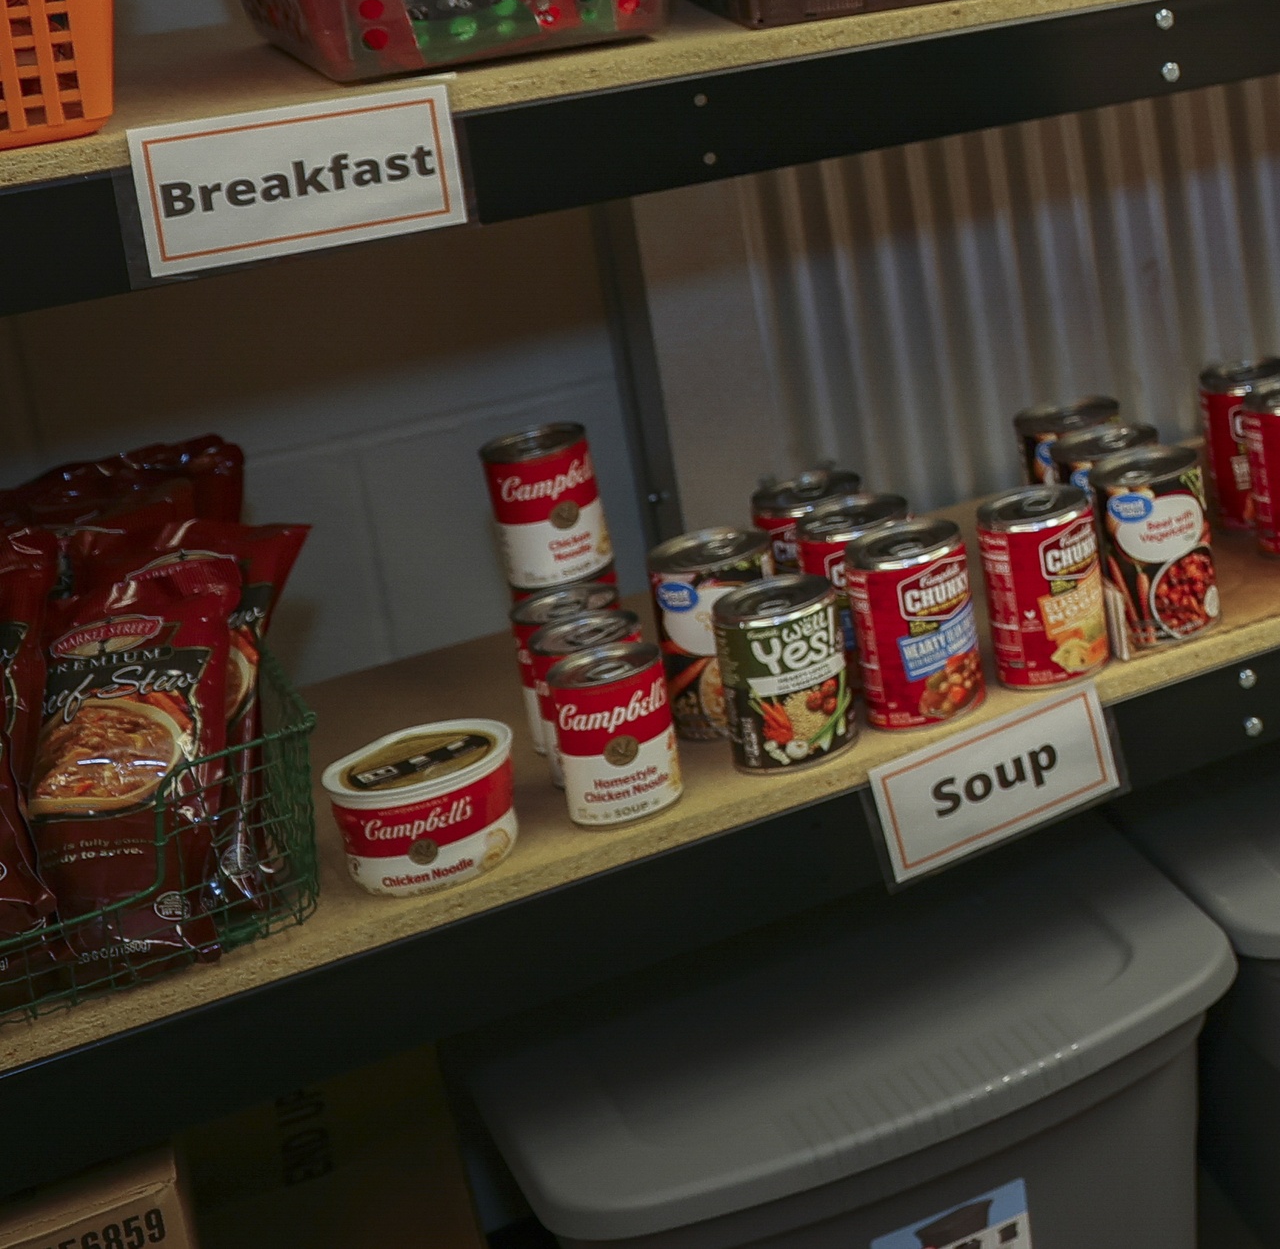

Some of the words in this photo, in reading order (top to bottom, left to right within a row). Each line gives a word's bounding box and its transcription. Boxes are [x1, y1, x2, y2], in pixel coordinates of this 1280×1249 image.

[160, 144, 436, 220] Breakfast
[57, 626, 108, 651] MARKET
[109, 622, 150, 636] STREET
[44, 674, 95, 724] eef
[97, 665, 197, 700] Stew
[555, 676, 666, 734] Campbell's
[584, 787, 631, 803] Chicken
[633, 773, 669, 794] Noodle
[593, 764, 658, 789] Homestyle
[932, 744, 1057, 819] Soup
[361, 795, 473, 841] Campbell's
[614, 801, 649, 818] SOUP
[382, 872, 430, 888] Chicken
[432, 858, 474, 879] Noodle
